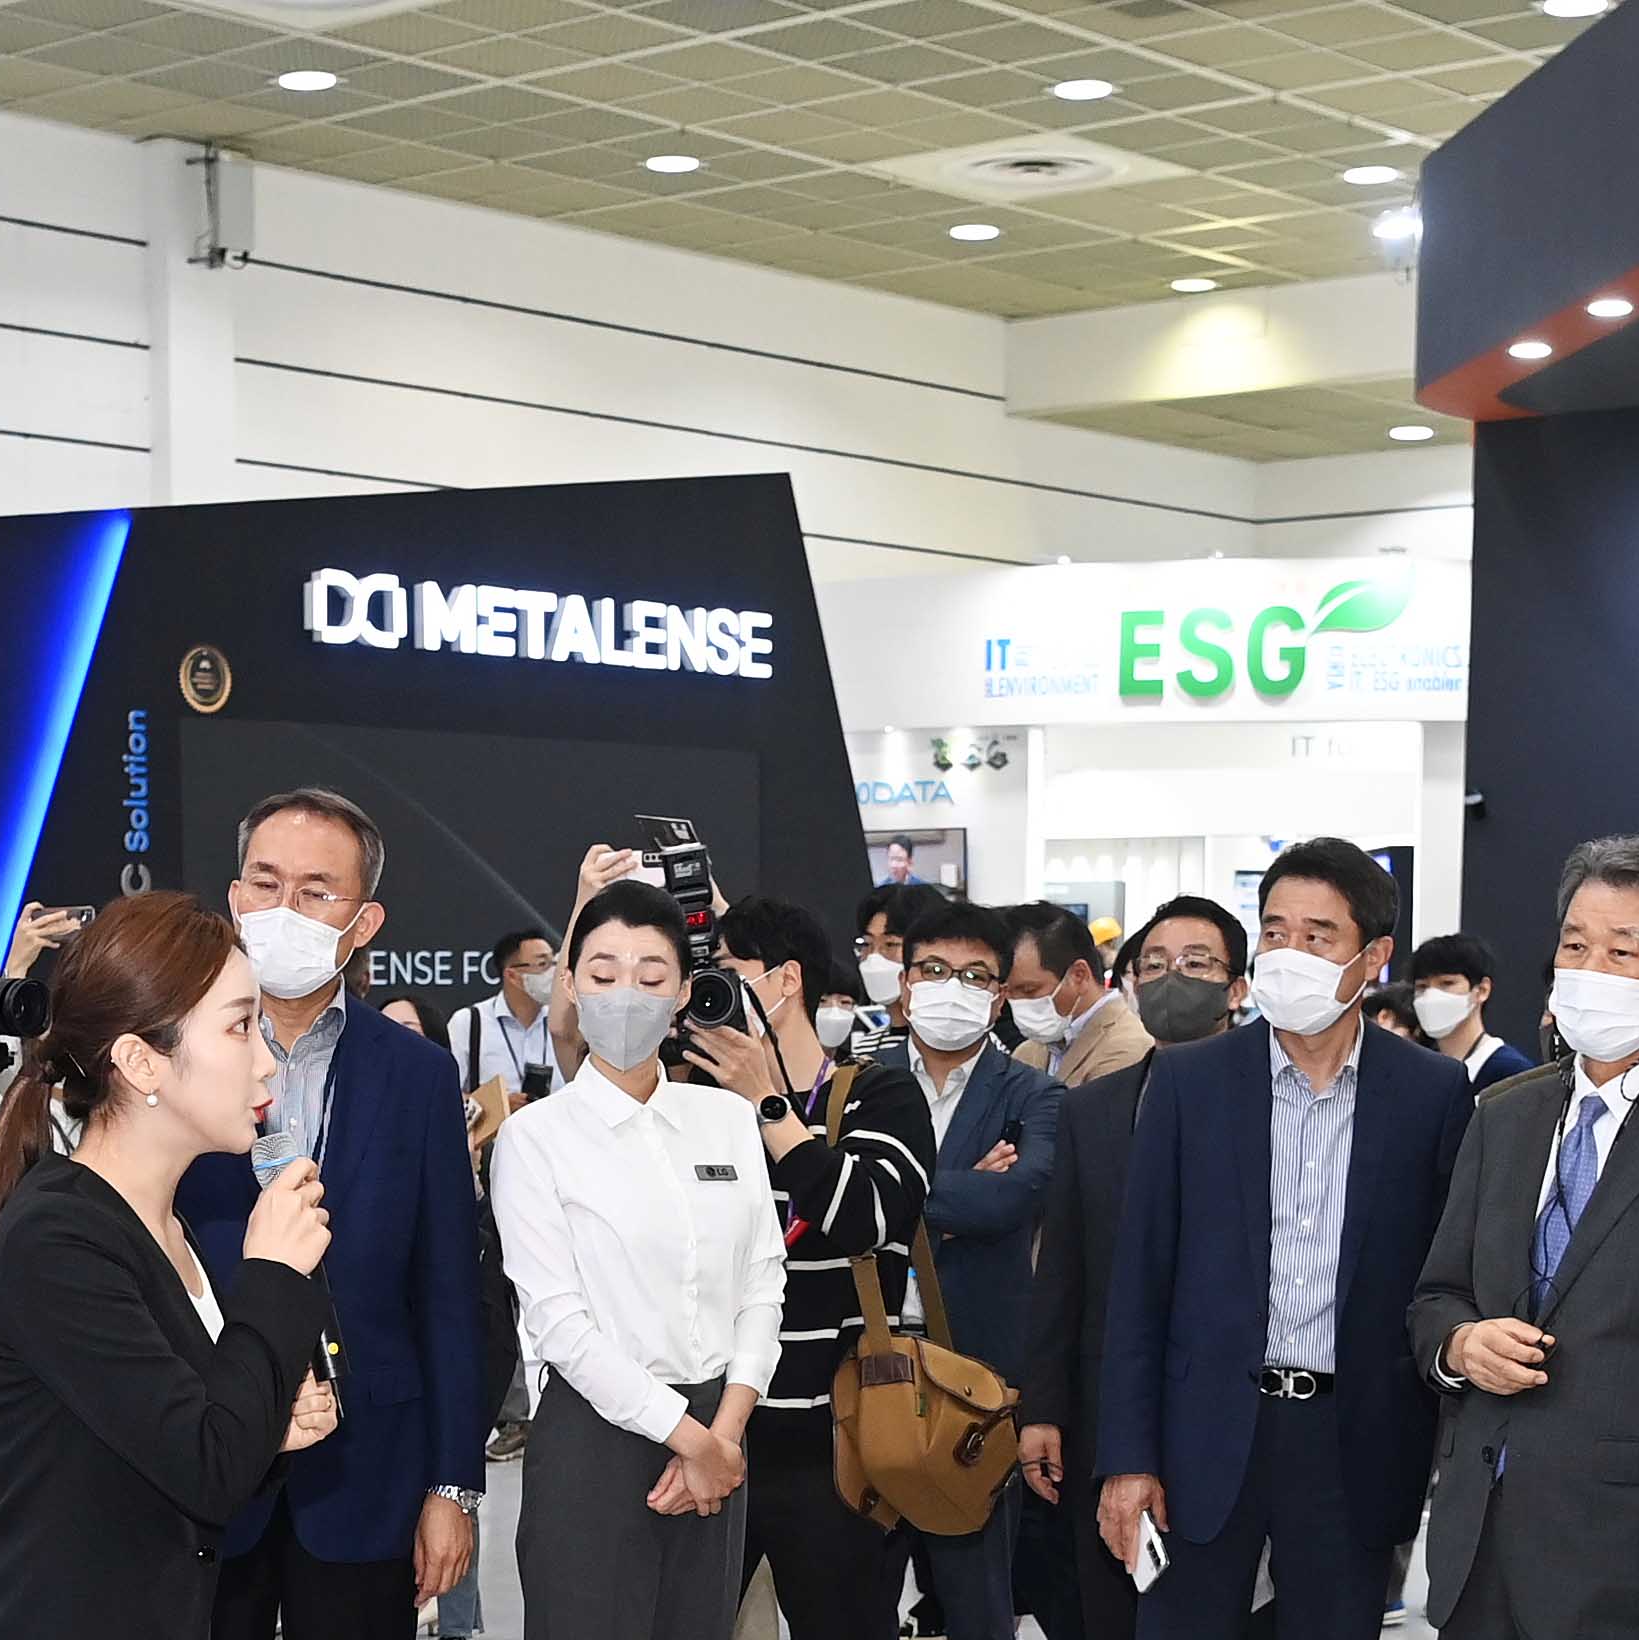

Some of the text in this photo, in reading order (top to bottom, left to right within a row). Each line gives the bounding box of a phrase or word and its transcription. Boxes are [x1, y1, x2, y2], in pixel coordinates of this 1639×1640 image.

[416, 579, 773, 679] METALENSE
[986, 639, 1010, 671] IT
[1118, 606, 1306, 699] ESG
[120, 709, 151, 898] C Solution
[368, 950, 454, 986] ENSE
